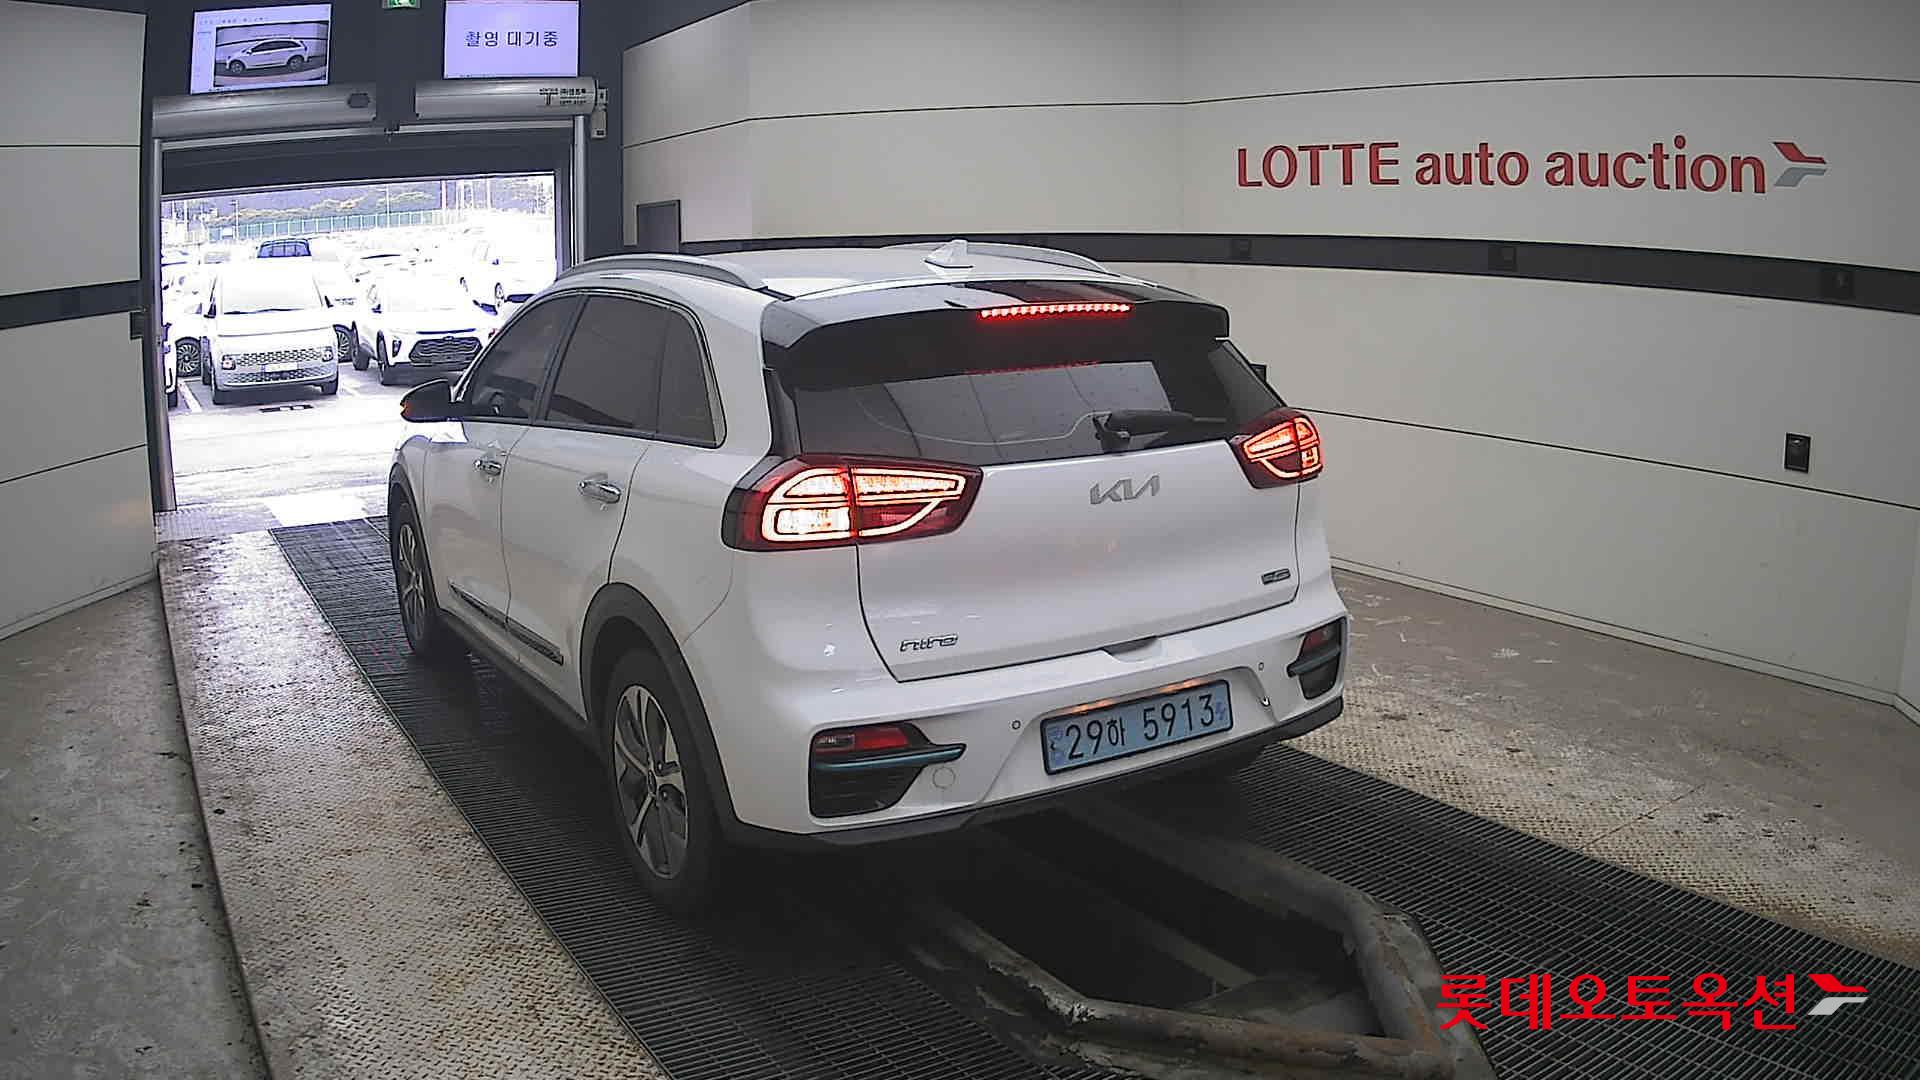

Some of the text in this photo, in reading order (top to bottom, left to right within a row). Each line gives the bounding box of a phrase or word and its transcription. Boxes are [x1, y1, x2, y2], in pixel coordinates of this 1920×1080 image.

[508, 30, 558, 47] 대기중
[1238, 136, 1767, 193] LOTTE auto auction
[1065, 694, 1214, 760] 29하 5913
